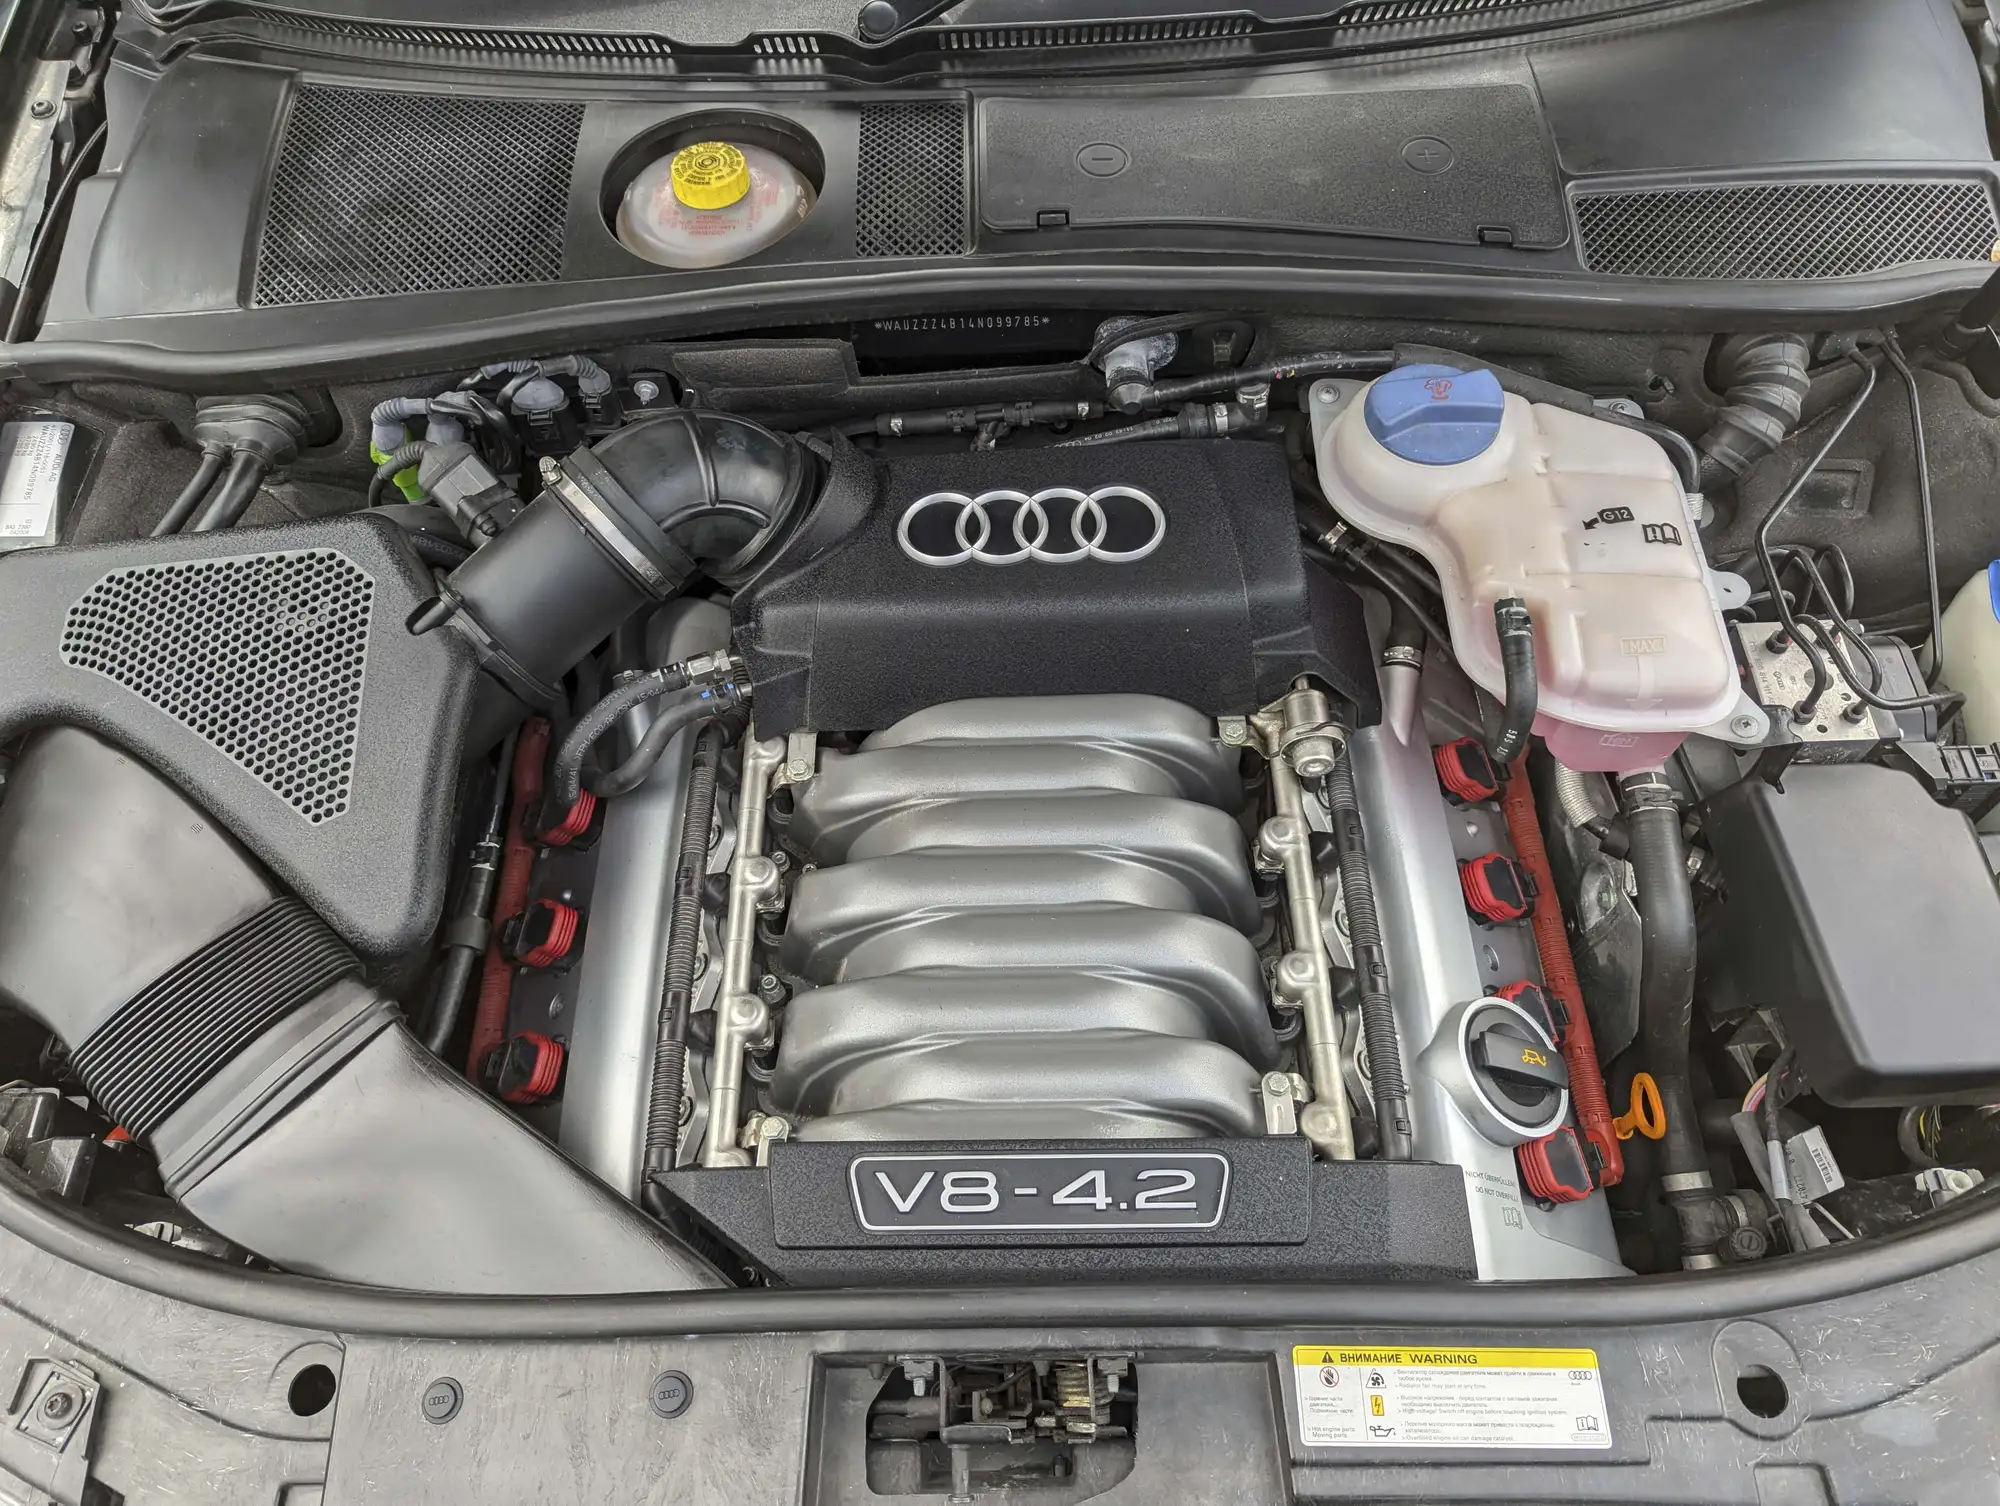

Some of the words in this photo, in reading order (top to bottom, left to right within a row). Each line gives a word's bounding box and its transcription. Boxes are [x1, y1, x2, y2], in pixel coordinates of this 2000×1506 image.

[1603, 509, 1630, 521] G12
[1629, 639, 1657, 653] MAX
[1465, 1170, 1484, 1179] NICHT
[1484, 1188, 1495, 1196] NOT
[1340, 1353, 1403, 1364] ВНИМАНИЕ
[1409, 1354, 1478, 1365] WARNING
